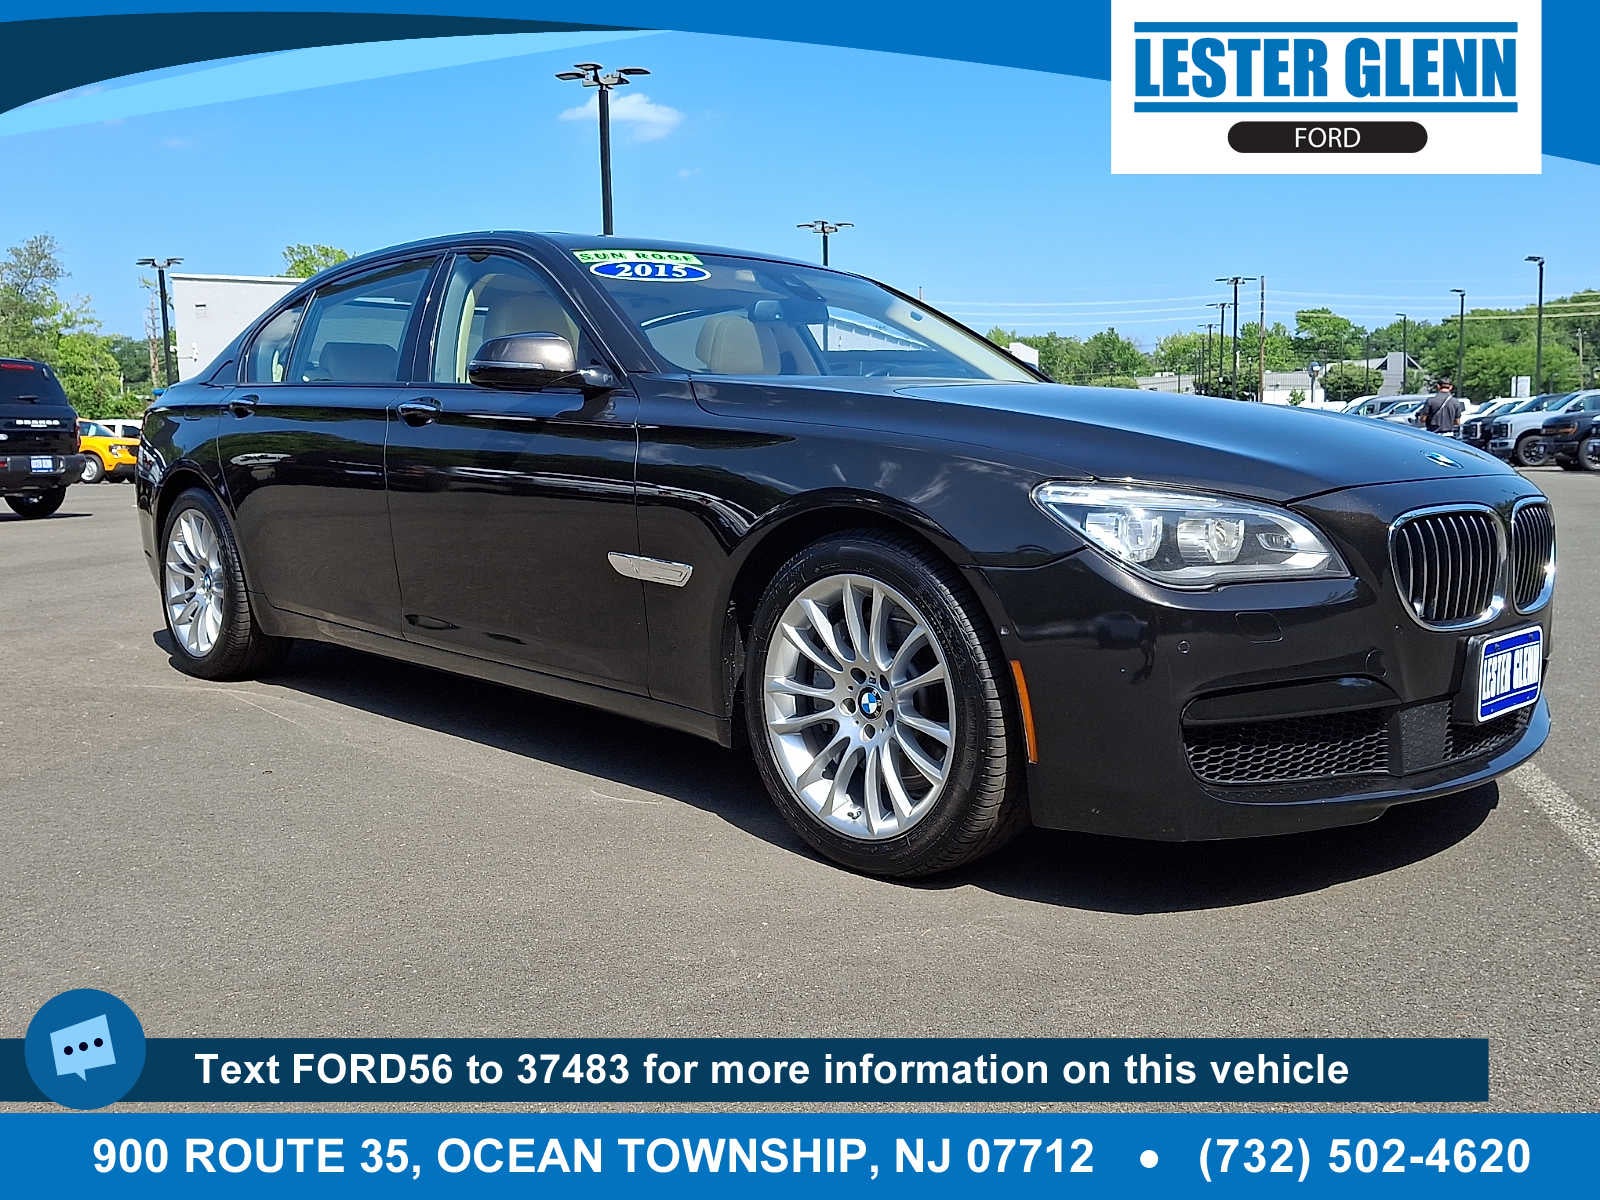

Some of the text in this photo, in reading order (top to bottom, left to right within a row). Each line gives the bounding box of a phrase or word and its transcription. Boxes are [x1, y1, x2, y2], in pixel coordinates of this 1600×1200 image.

[579, 252, 696, 262] SUN ROOF
[615, 264, 688, 278] 2015
[1482, 645, 1540, 700] LESTER GLENN
